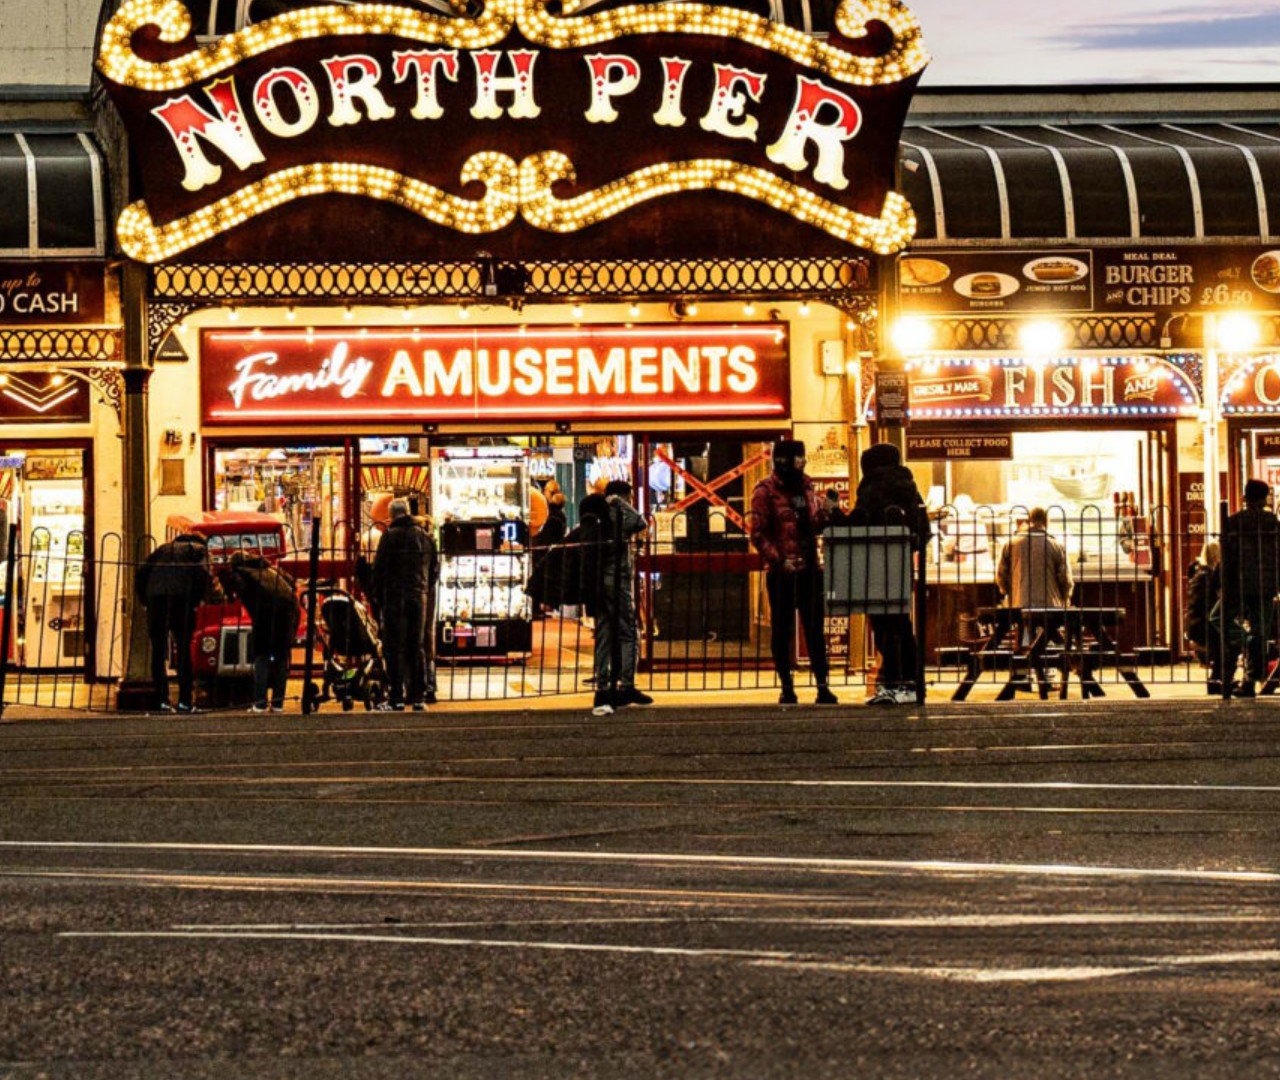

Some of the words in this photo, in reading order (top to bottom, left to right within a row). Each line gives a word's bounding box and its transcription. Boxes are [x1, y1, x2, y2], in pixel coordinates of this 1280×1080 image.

[150, 48, 541, 192] NORTH
[583, 52, 863, 190] PIER
[1124, 252, 1149, 261] MEAL
[1152, 252, 1178, 261] DEAL
[1105, 265, 1195, 285] BURGER
[0, 280, 24, 302] up
[25, 274, 43, 289] to
[1053, 284, 1069, 292] HOT
[1070, 283, 1087, 292] DOG
[1126, 286, 1192, 307] CHIPS
[1200, 283, 1254, 307] £6.50
[12, 291, 79, 314] CASH
[228, 341, 374, 409] Family
[380, 346, 759, 398] AMUSEMENTS
[1002, 366, 1117, 408] FISH
[1123, 375, 1159, 395] AND
[908, 438, 942, 448] PLEASE
[943, 437, 982, 447] COLLECT
[983, 436, 1009, 447] FOOD
[946, 448, 971, 457] HERE
